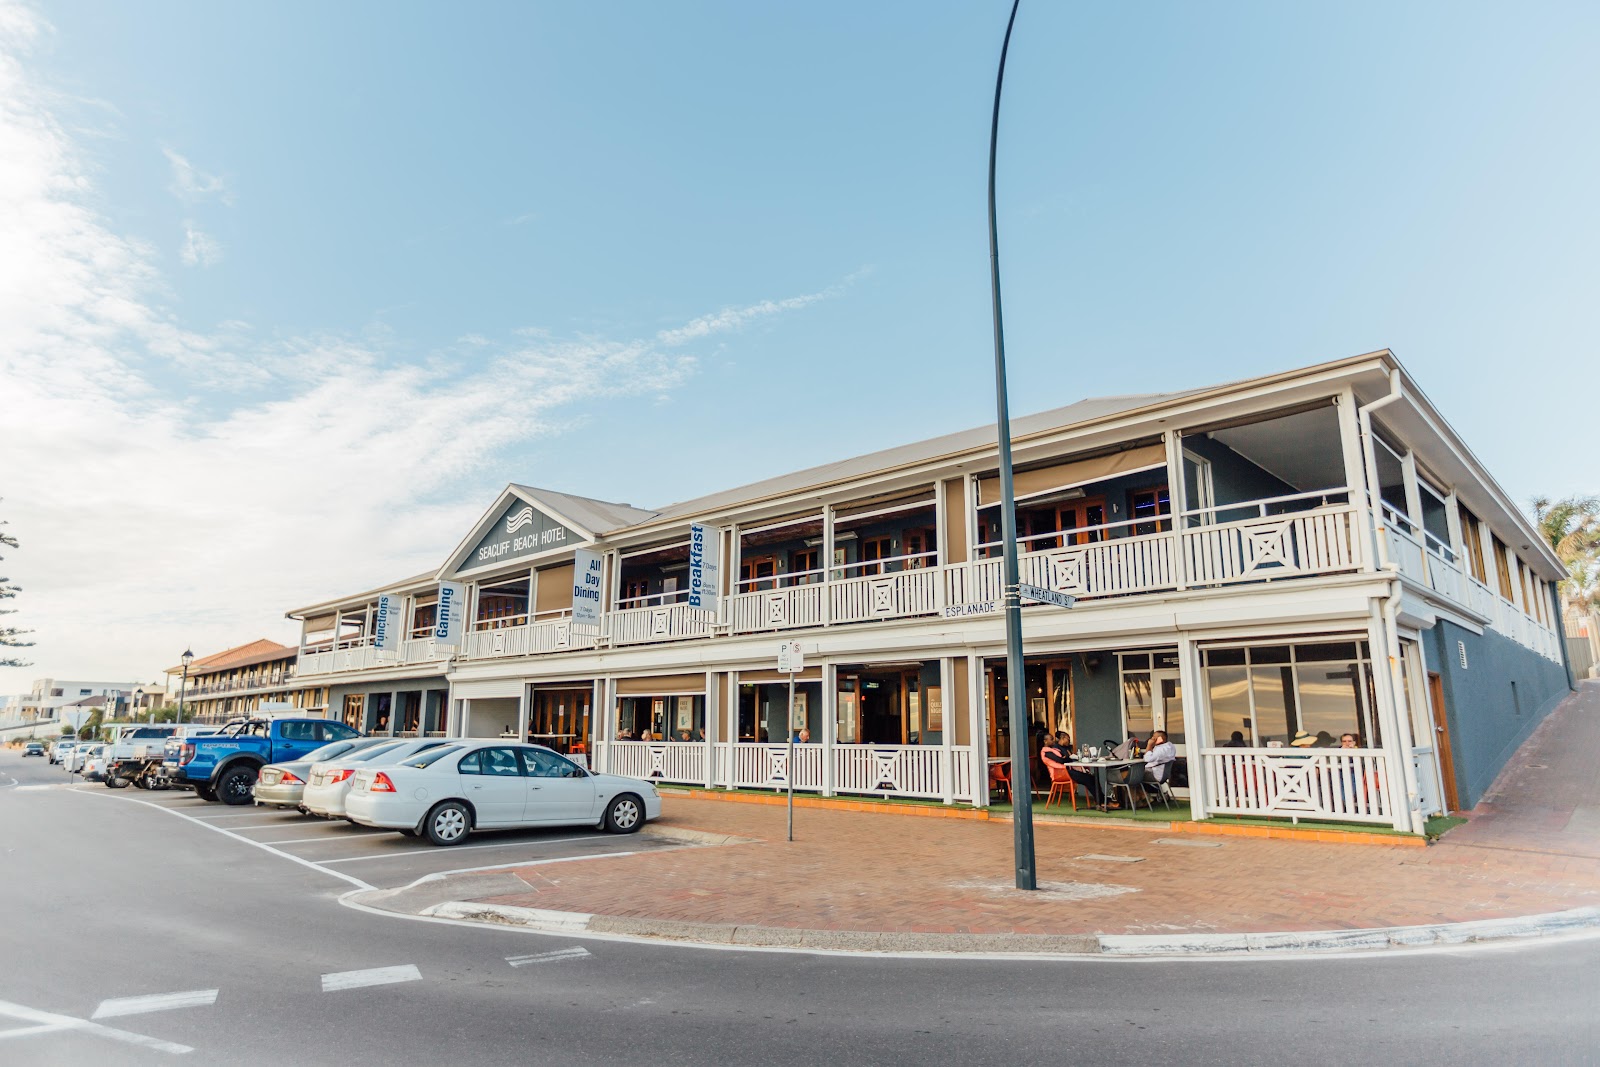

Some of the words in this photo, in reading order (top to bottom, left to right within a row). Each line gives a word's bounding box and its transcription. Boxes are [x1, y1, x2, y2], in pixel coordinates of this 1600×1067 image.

[478, 541, 511, 561] SEACLIFF
[513, 533, 539, 552] BEACH
[541, 526, 566, 545] HOTEL
[589, 559, 601, 571] All
[689, 525, 703, 607] Breakfast
[705, 562, 717, 571] Days
[585, 572, 600, 588] Day
[574, 585, 600, 602] Dining
[1030, 588, 1062, 605] WHEATLAND
[436, 587, 454, 638] Gaming
[945, 601, 996, 618] ESPLANADE
[374, 596, 389, 648] Functions
